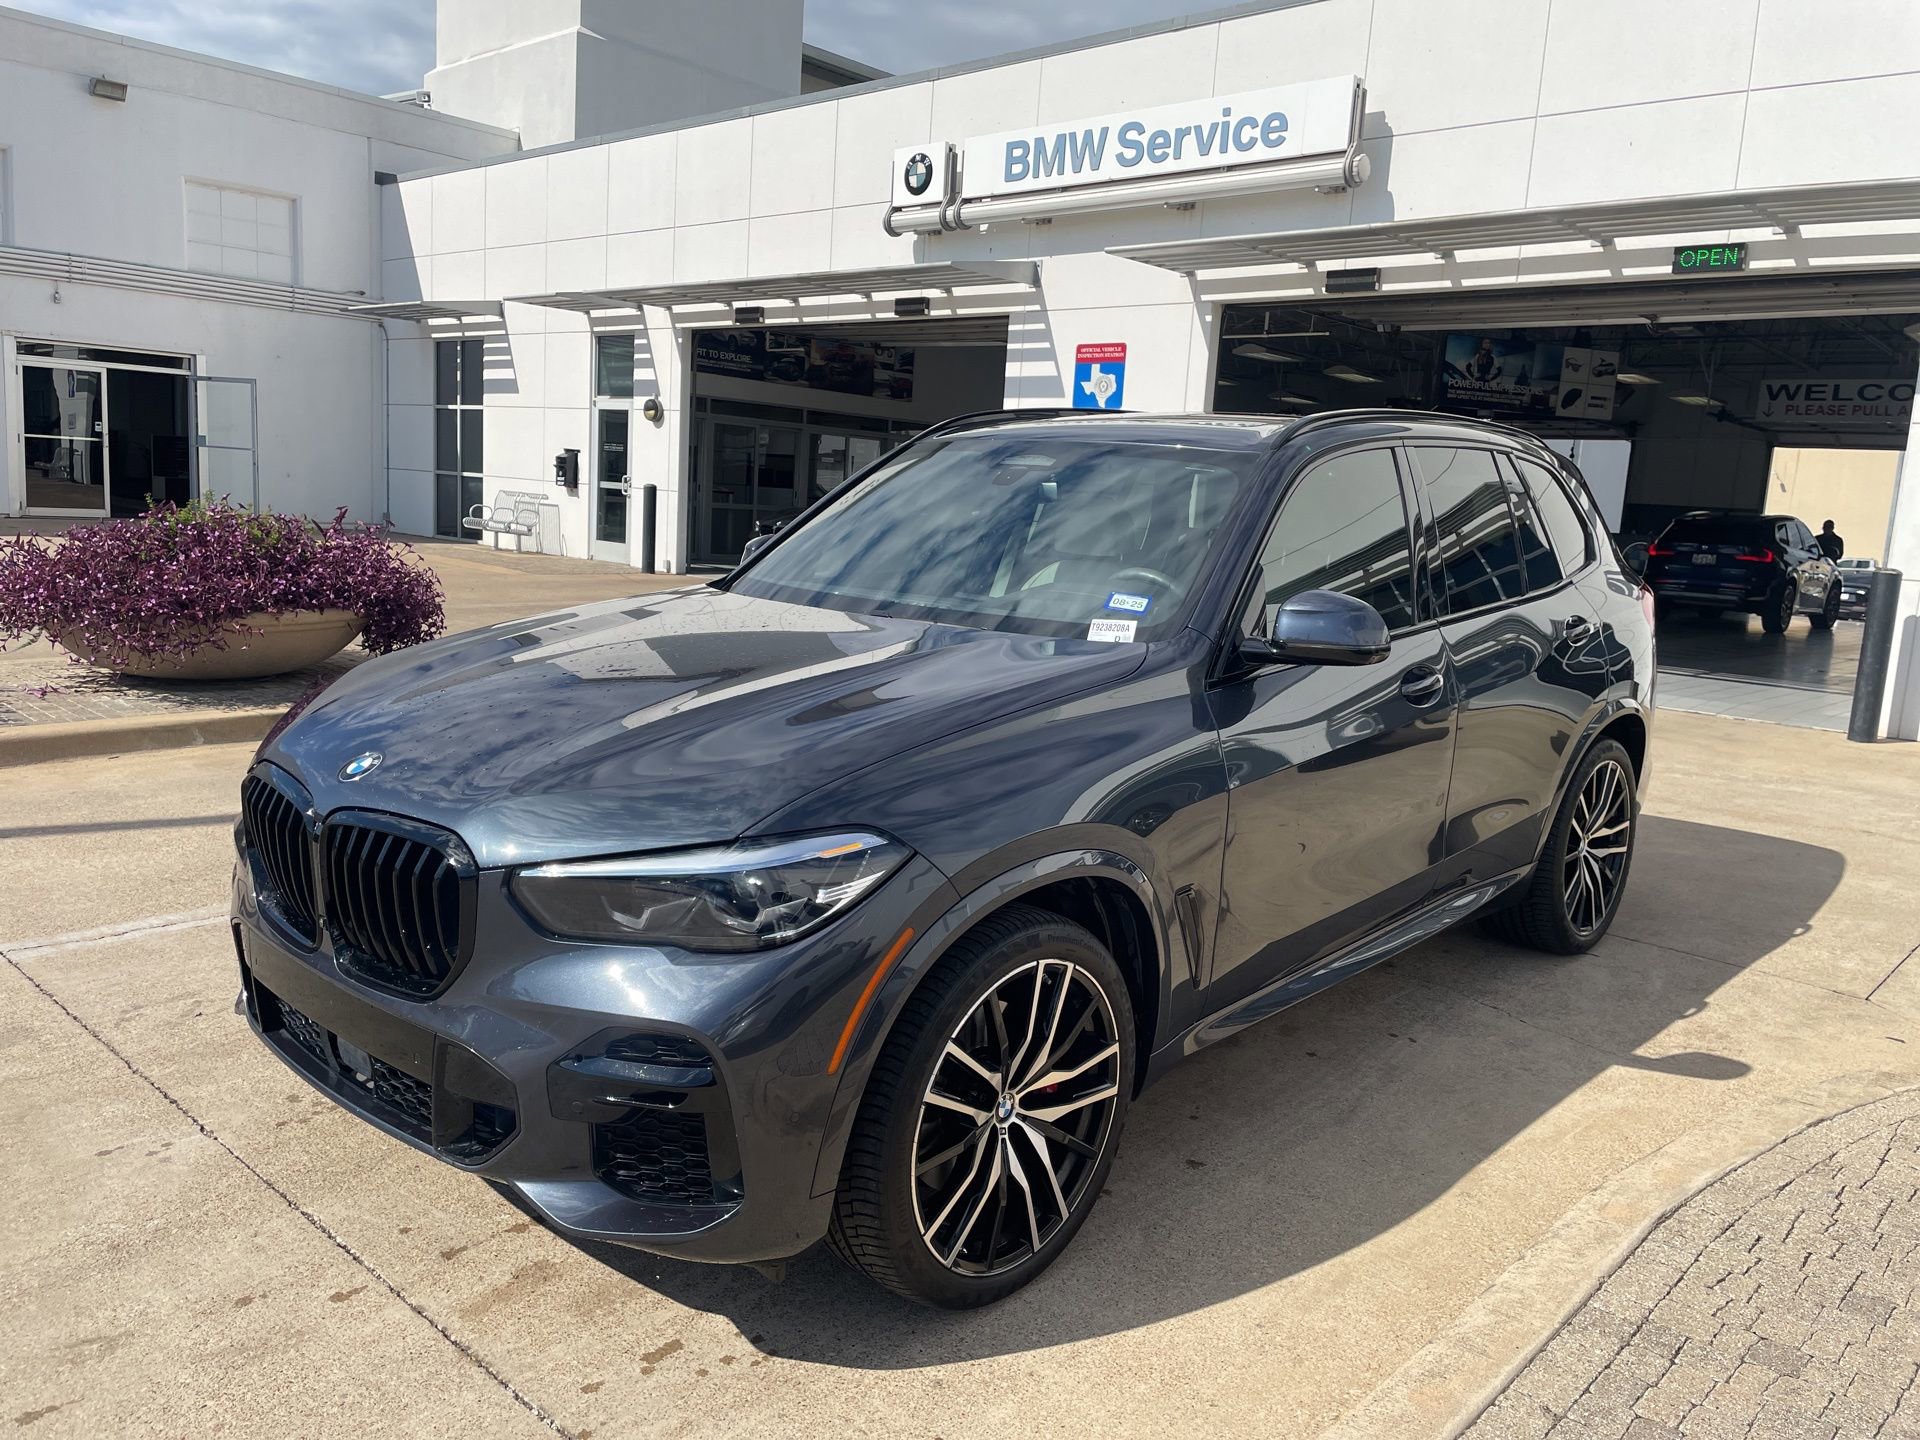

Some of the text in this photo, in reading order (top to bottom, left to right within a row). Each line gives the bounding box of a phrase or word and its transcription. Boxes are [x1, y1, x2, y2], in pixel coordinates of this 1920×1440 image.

[1004, 107, 1289, 182] BMW Service
[1680, 247, 1738, 267] OPEN
[1448, 378, 1491, 391] POWERFUL
[1784, 404, 1847, 416] PLEASE
[1851, 404, 1893, 416] PULL
